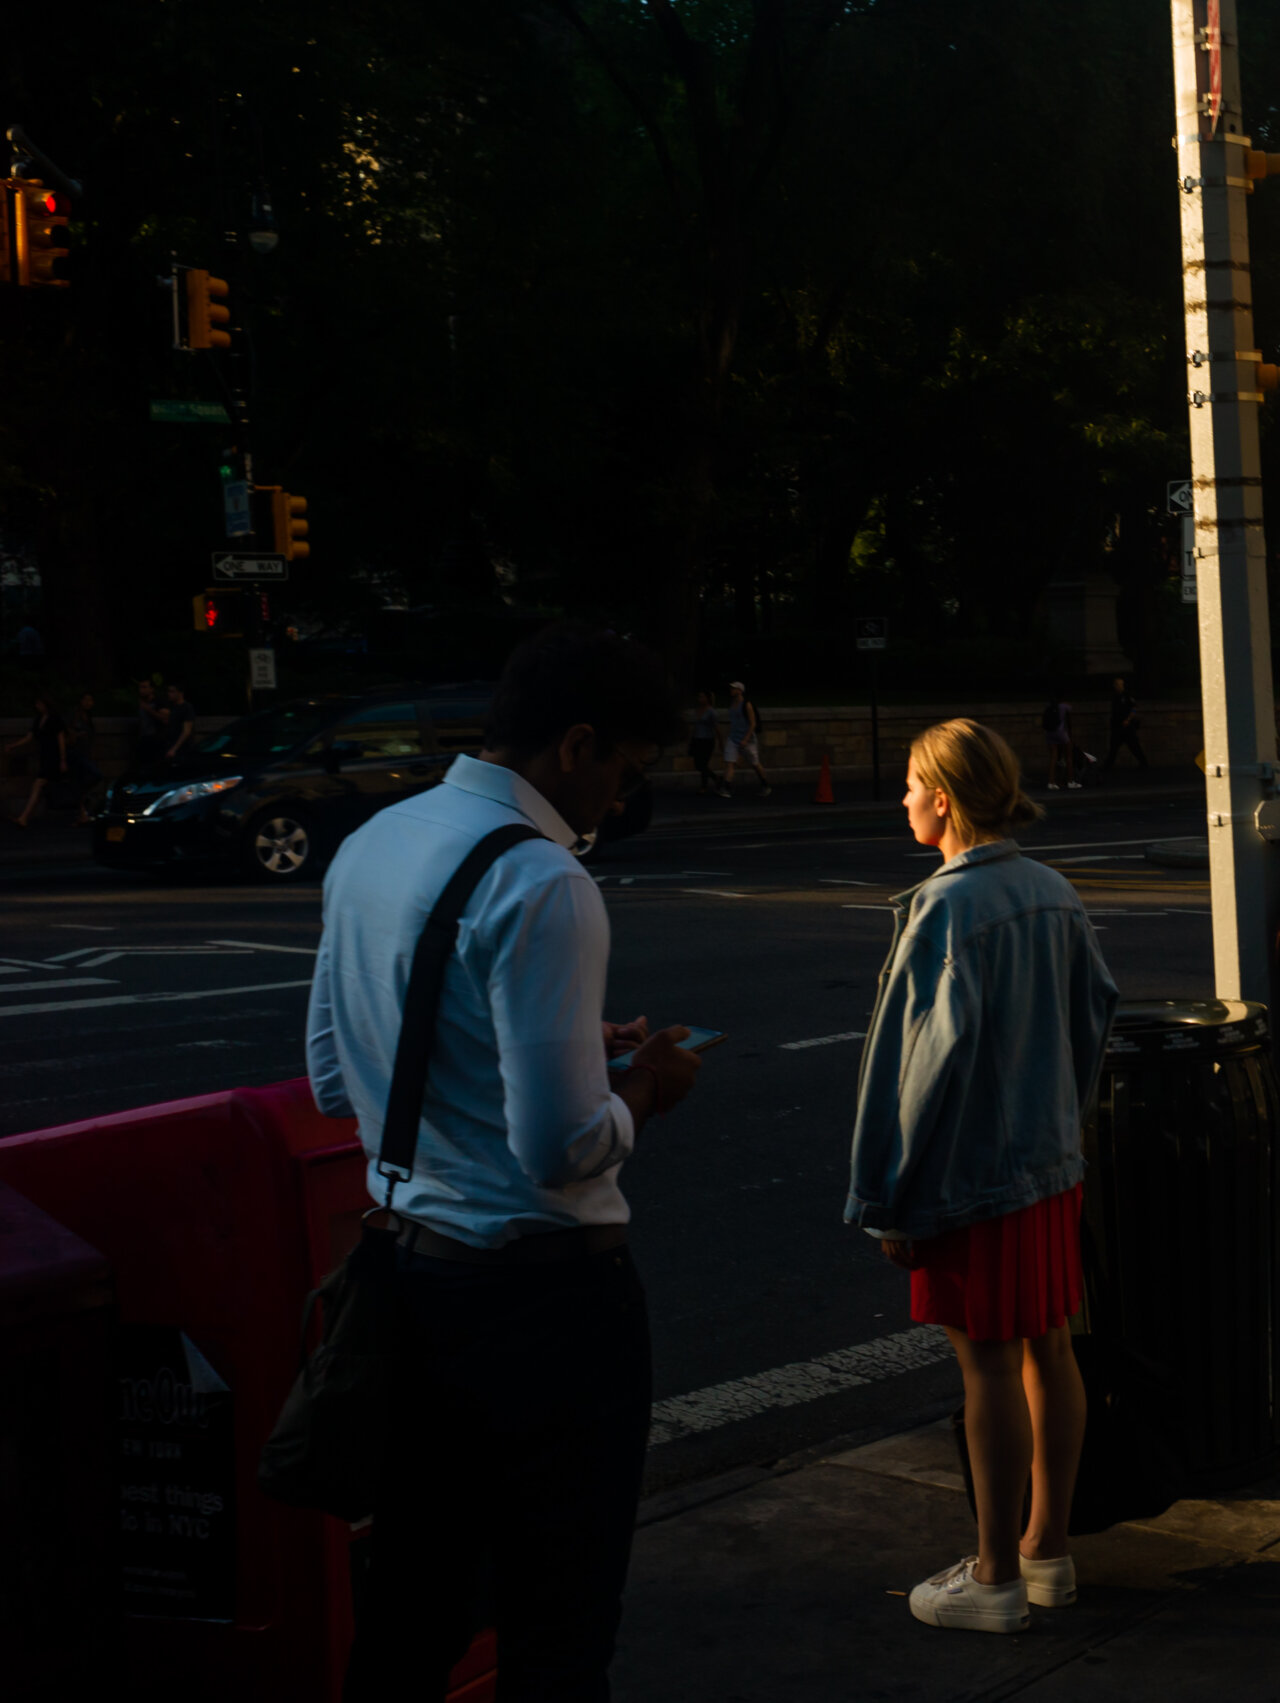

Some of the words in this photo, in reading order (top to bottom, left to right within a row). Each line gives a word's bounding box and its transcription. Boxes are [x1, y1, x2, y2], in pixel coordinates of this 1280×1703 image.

[223, 561, 246, 571] ONE
[257, 561, 280, 571] WAY
[164, 1482, 225, 1516] things
[168, 1513, 210, 1540] NYC
